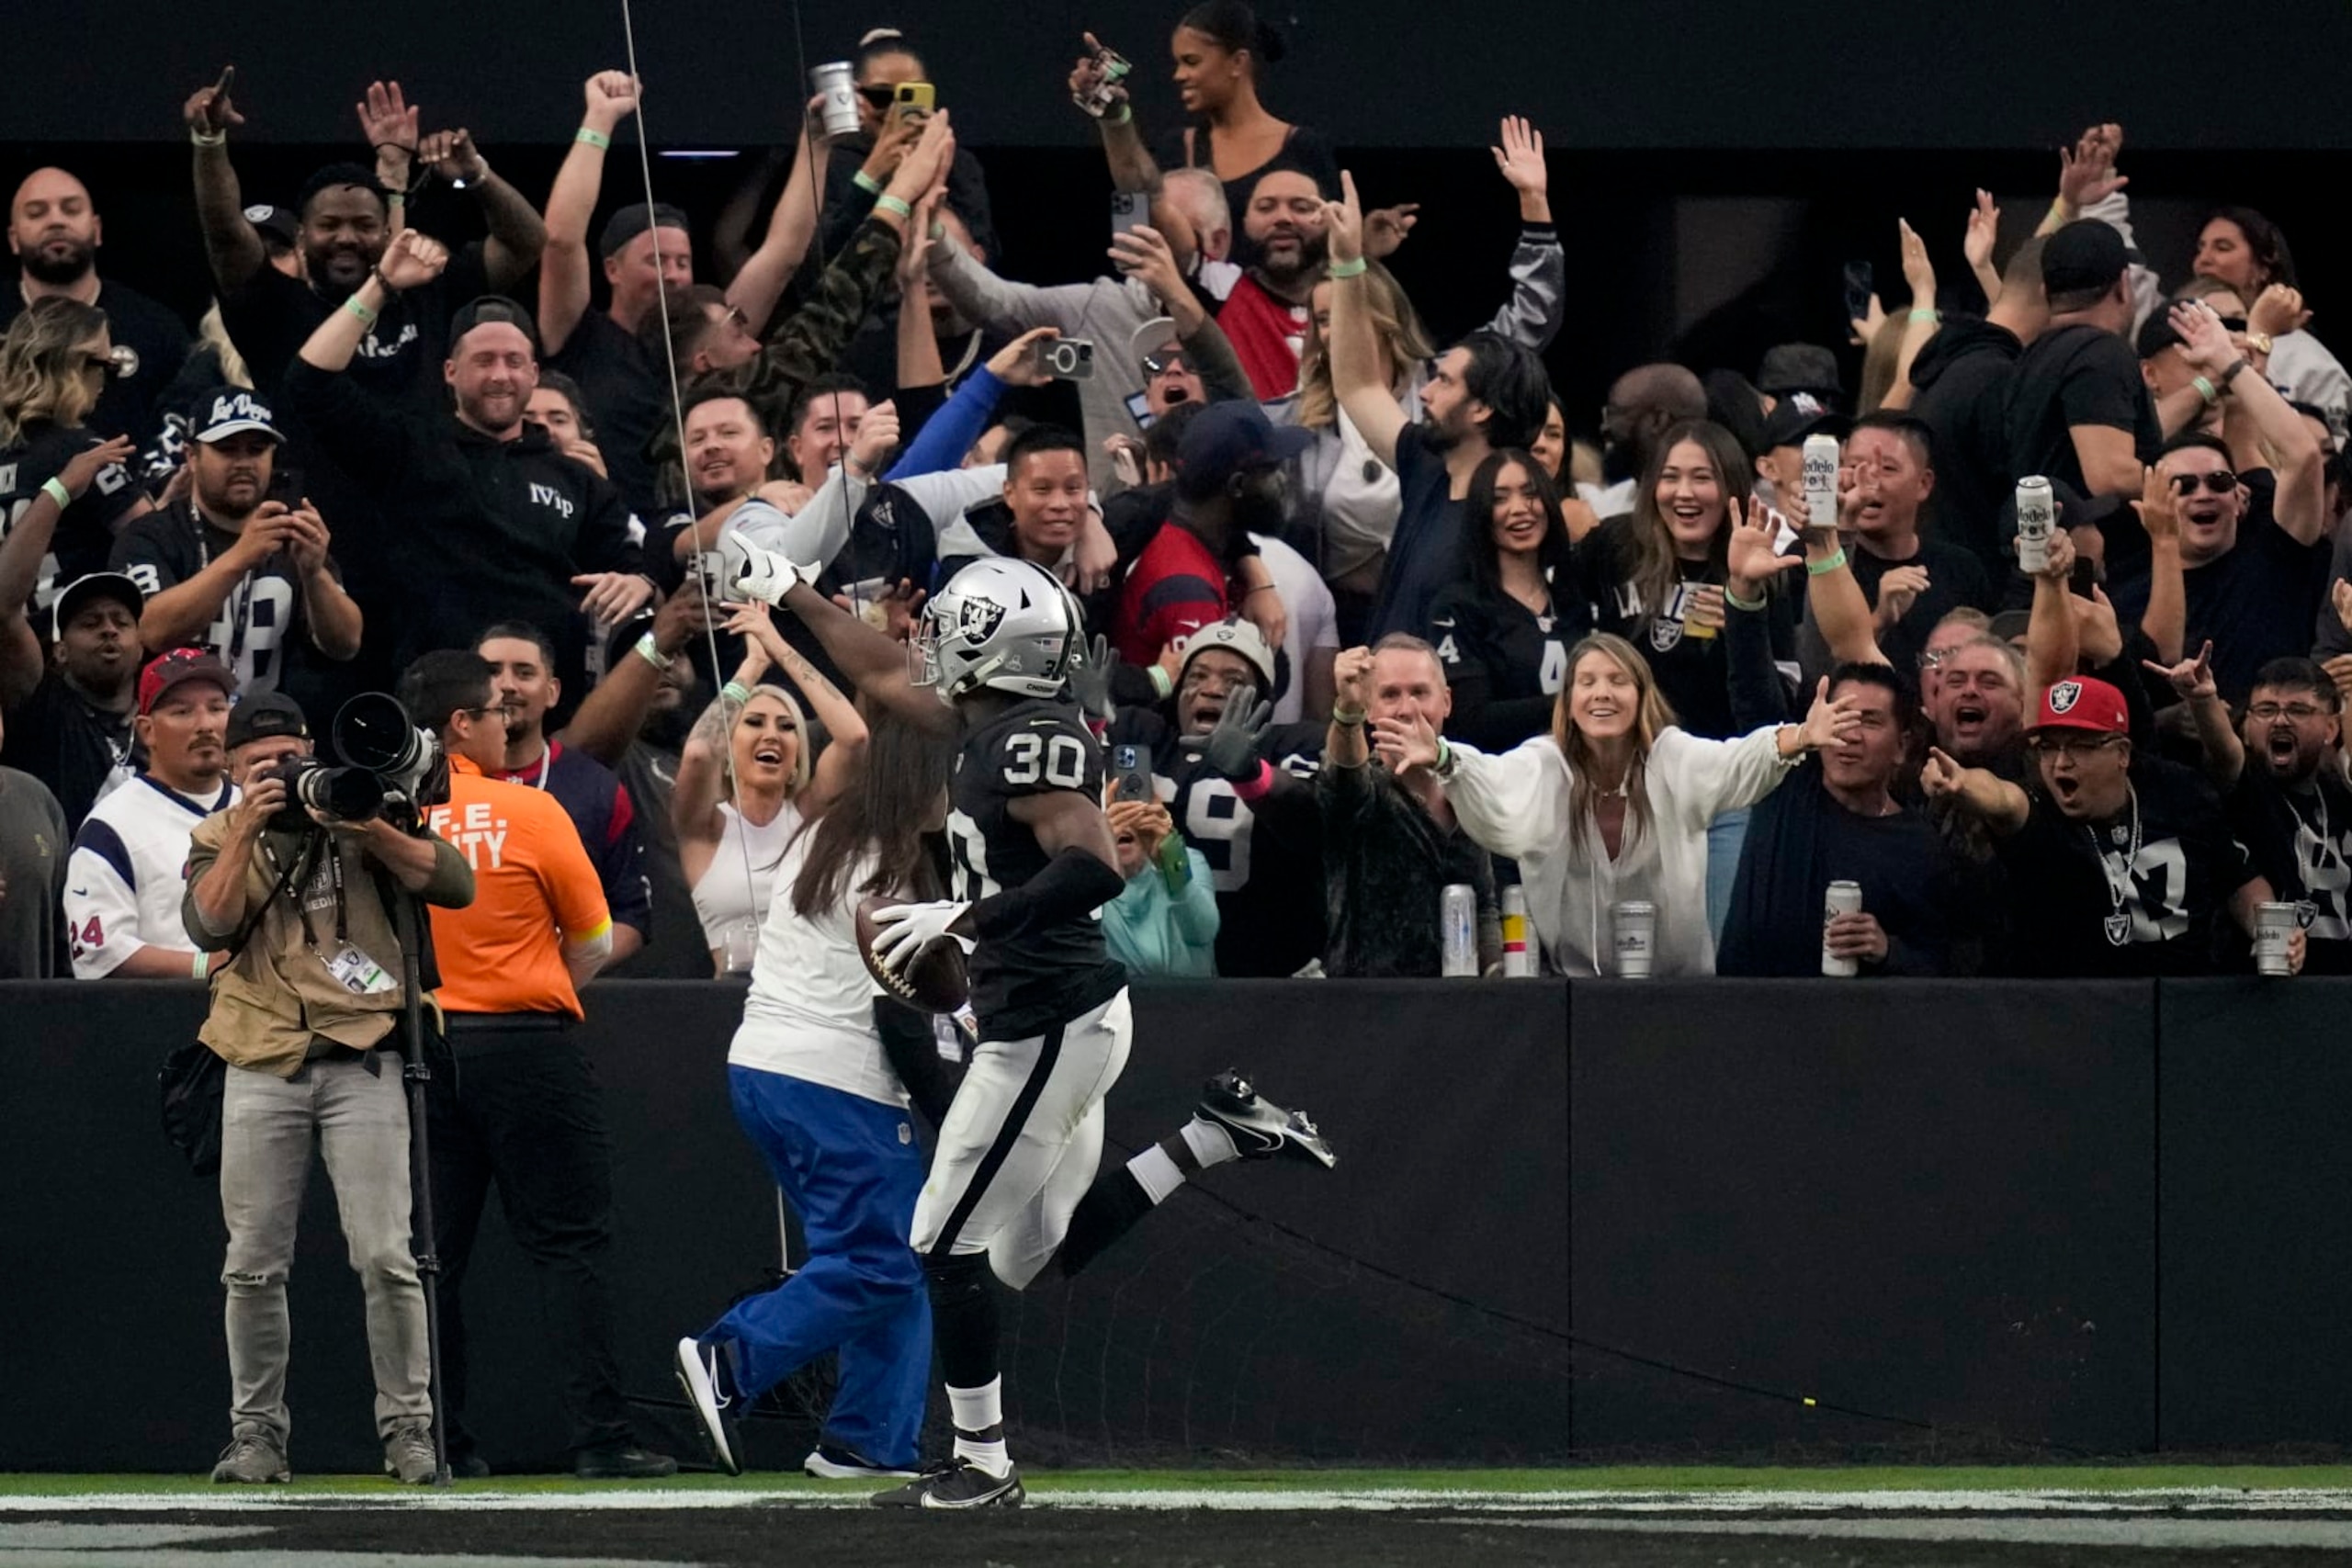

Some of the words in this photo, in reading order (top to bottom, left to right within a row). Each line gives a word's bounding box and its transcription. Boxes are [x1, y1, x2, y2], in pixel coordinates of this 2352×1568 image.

[1802, 459, 1835, 474] odelo
[1437, 634, 1462, 664] 4
[1003, 733, 1086, 788] 30
